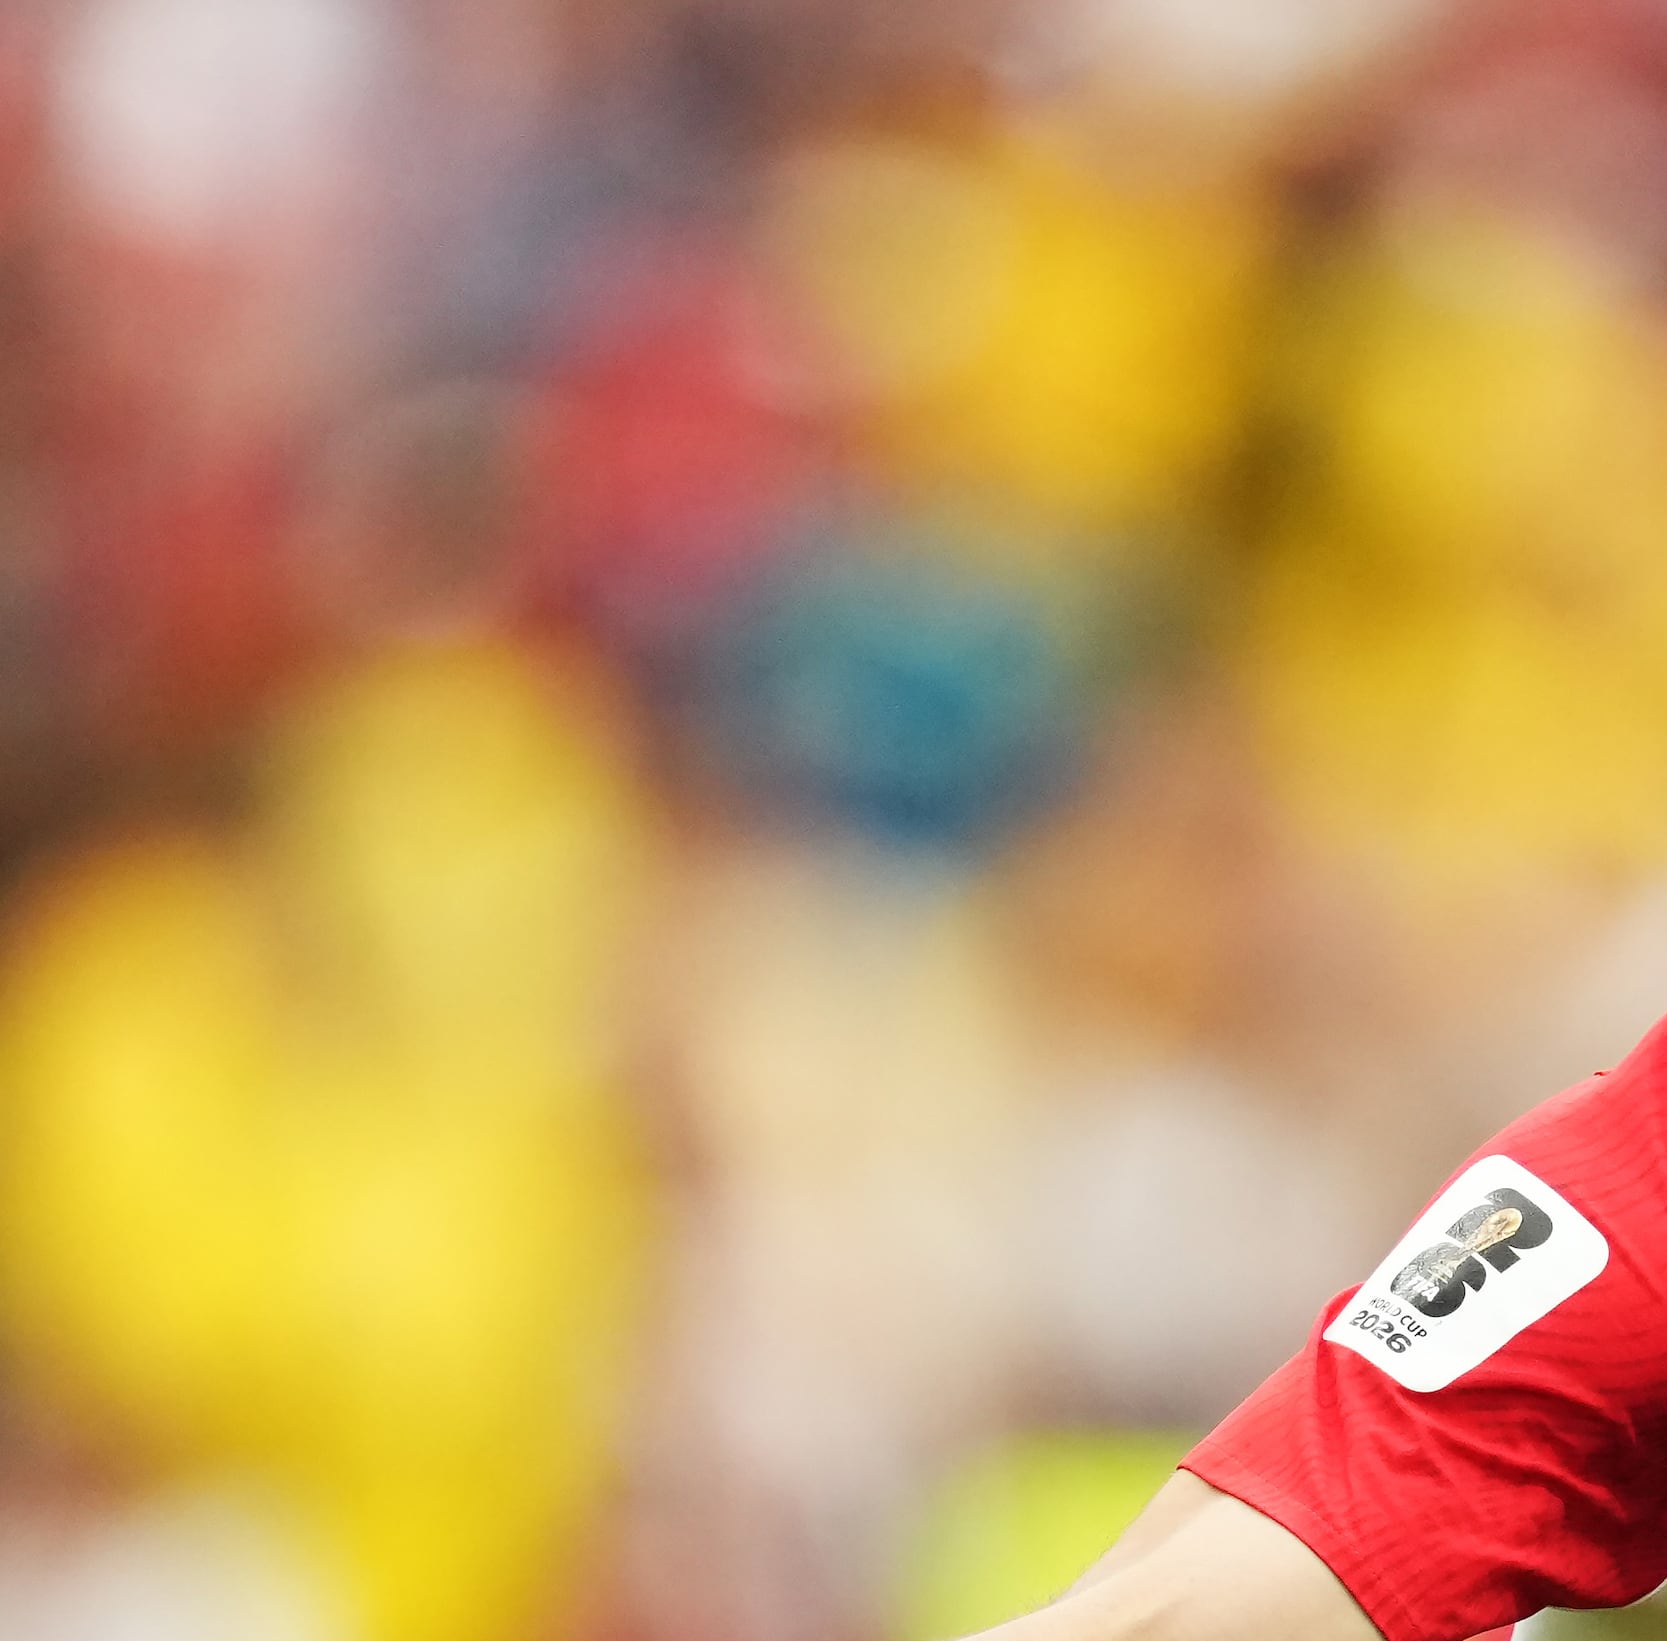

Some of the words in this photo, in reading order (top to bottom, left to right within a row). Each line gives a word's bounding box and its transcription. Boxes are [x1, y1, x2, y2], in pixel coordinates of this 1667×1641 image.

[1349, 1310, 1412, 1354] 2026
[1369, 1297, 1402, 1317] WORLD
[1400, 1314, 1427, 1338] CUP
